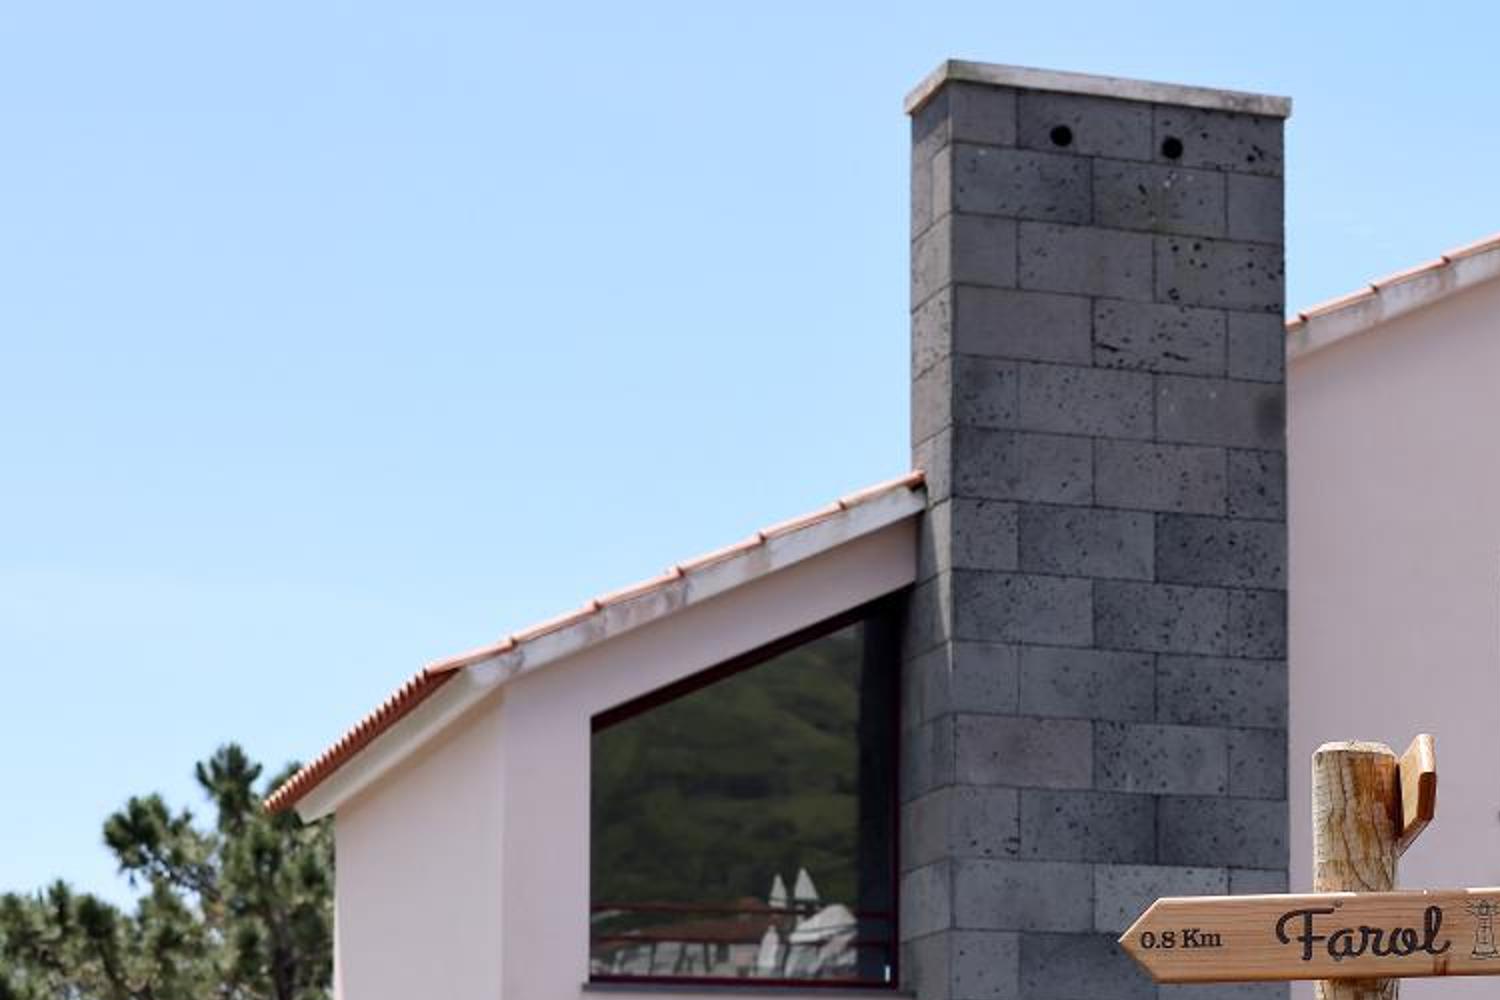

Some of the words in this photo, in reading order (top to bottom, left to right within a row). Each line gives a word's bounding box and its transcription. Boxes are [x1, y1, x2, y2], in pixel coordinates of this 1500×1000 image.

[1140, 931, 1176, 949] 0.8
[1182, 929, 1222, 948] Km
[1276, 906, 1451, 961] Farol
